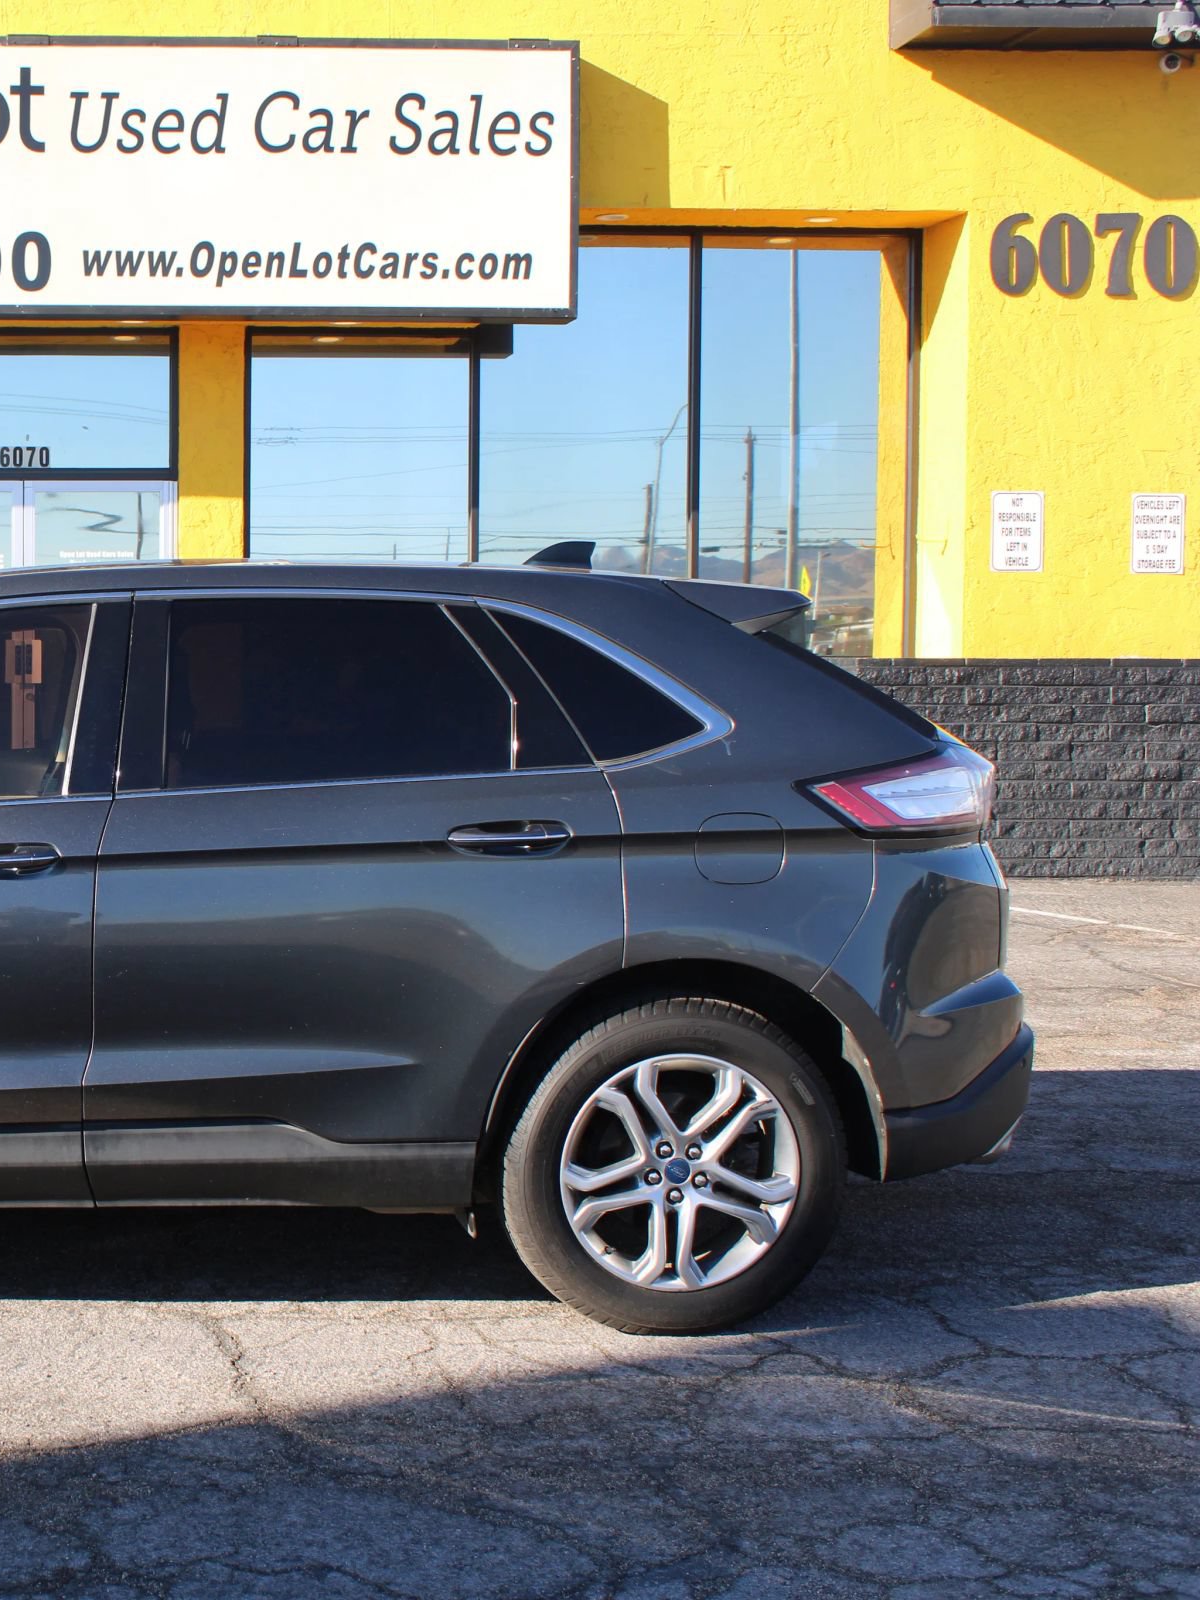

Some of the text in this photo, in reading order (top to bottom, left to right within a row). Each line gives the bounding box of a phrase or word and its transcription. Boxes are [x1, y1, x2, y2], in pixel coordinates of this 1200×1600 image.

[69, 91, 229, 154] Used
[254, 90, 370, 154] Car
[389, 92, 555, 156] Sales
[990, 212, 1199, 300] 6070
[82, 241, 533, 287] www.OpenLotCars.com
[0, 446, 50, 468] 6070
[1012, 498, 1023, 507] NOT
[1137, 500, 1180, 510] VEHICLES LEFT
[998, 512, 1037, 522] RESPONSIBLE
[1135, 515, 1180, 525] OVERNIGHT ARE
[1001, 527, 1031, 537] FOR ITEMS
[1136, 530, 1162, 539] SUBJECT
[1164, 530, 1171, 539] TO
[1006, 542, 1027, 551] LEFT IN
[1005, 556, 1029, 566] VEHICLE
[1137, 559, 1176, 569] STORAGE FEE
